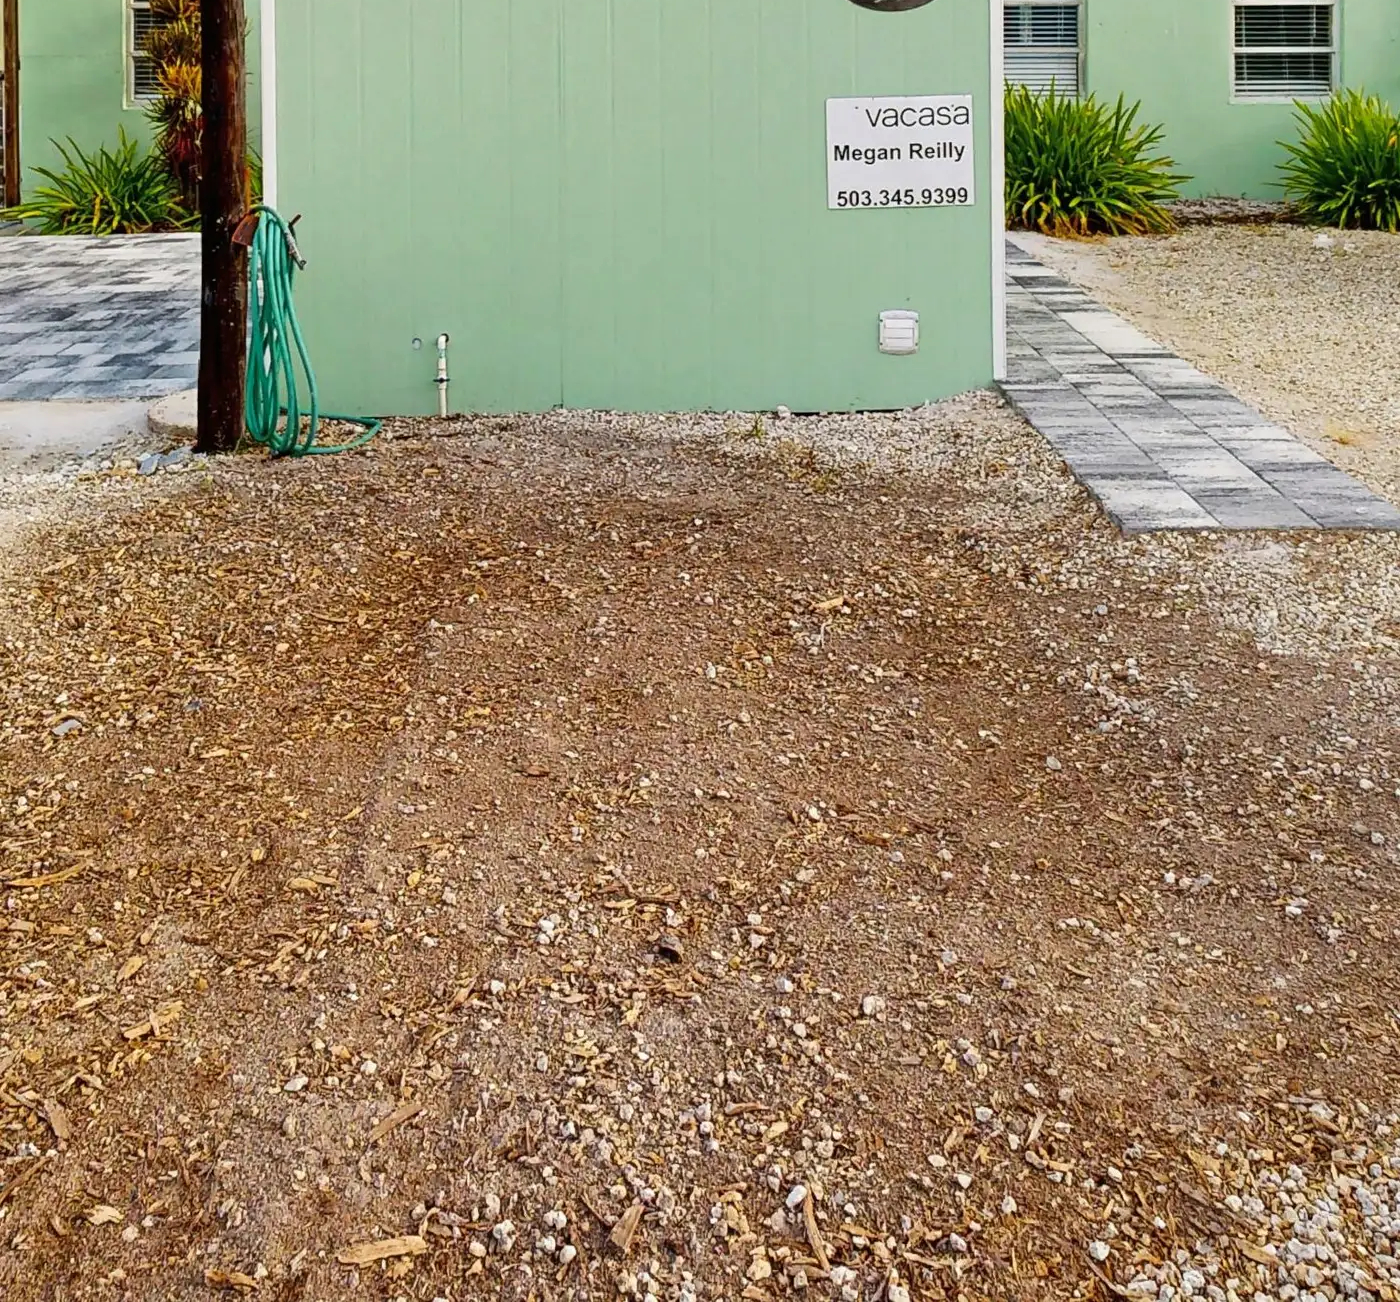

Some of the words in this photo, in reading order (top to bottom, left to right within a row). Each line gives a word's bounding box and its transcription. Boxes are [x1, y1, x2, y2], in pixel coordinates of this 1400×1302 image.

[865, 105, 970, 128] vacasa
[833, 144, 901, 165] Megan
[909, 141, 966, 162] Reilly
[837, 187, 968, 207] 503.345.9399
